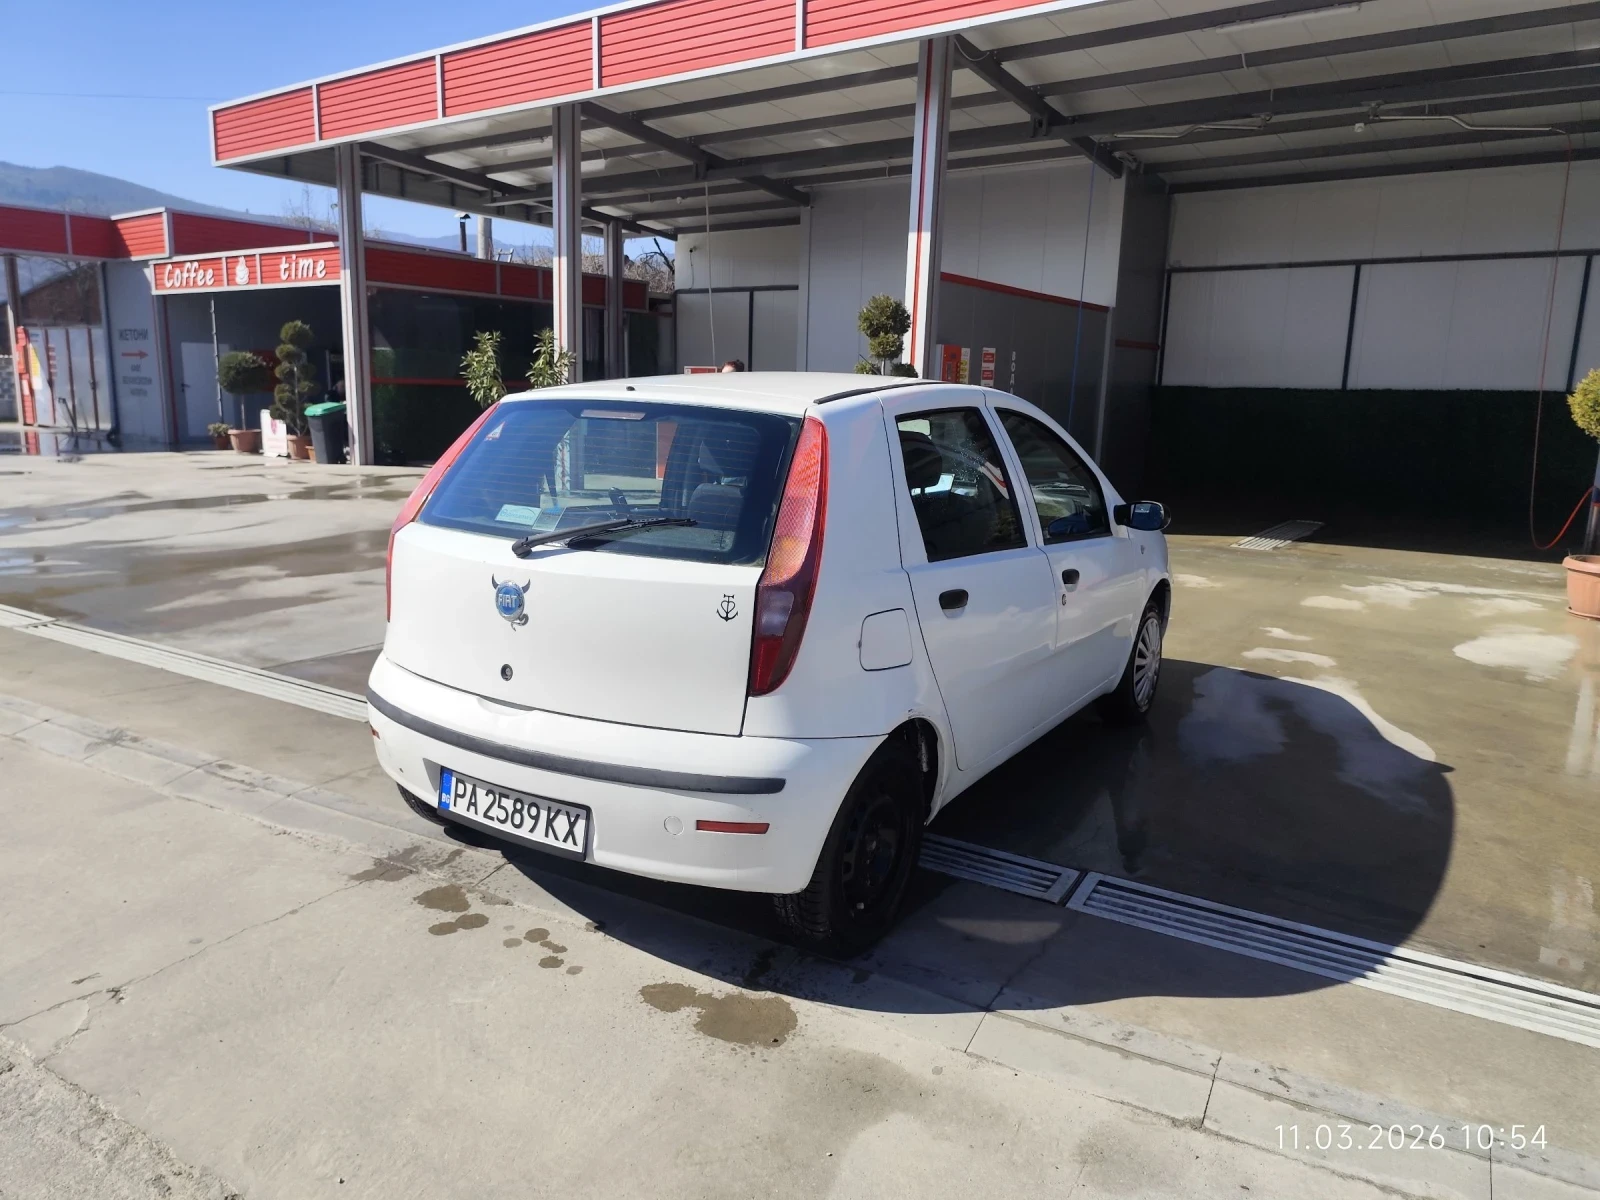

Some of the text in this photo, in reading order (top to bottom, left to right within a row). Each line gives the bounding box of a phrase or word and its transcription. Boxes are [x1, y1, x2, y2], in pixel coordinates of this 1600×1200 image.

[164, 254, 327, 288] Coffee time
[498, 593, 517, 608] FIAT
[441, 792, 450, 804] BG
[453, 777, 581, 847] PA 2589 KX
